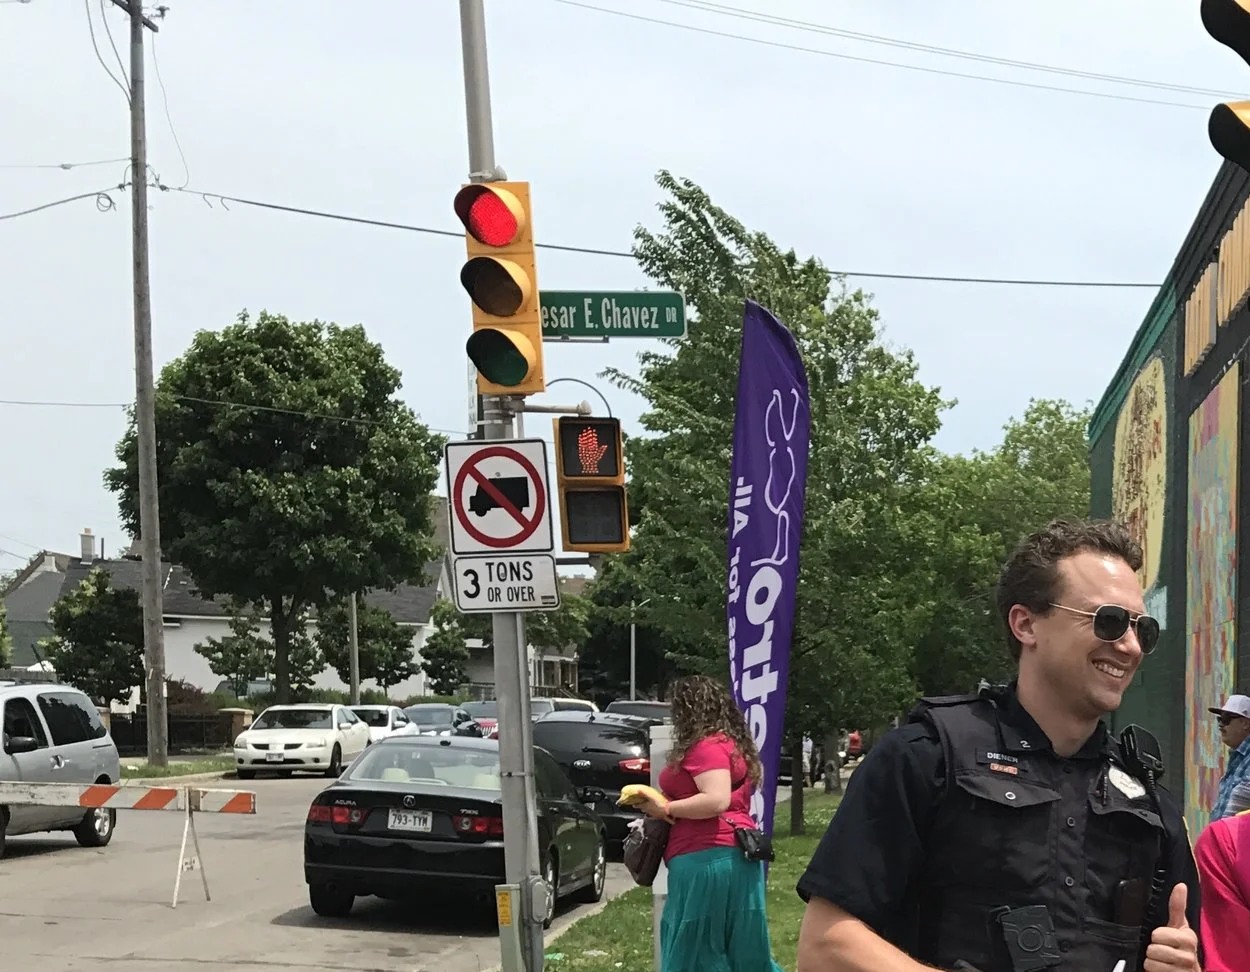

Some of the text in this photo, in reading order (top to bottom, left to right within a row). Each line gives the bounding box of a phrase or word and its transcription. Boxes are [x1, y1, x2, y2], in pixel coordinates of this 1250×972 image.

[541, 297, 678, 329] esar E. Chavez DR
[463, 560, 534, 599] 3 TONS
[487, 585, 536, 602] OR OVER
